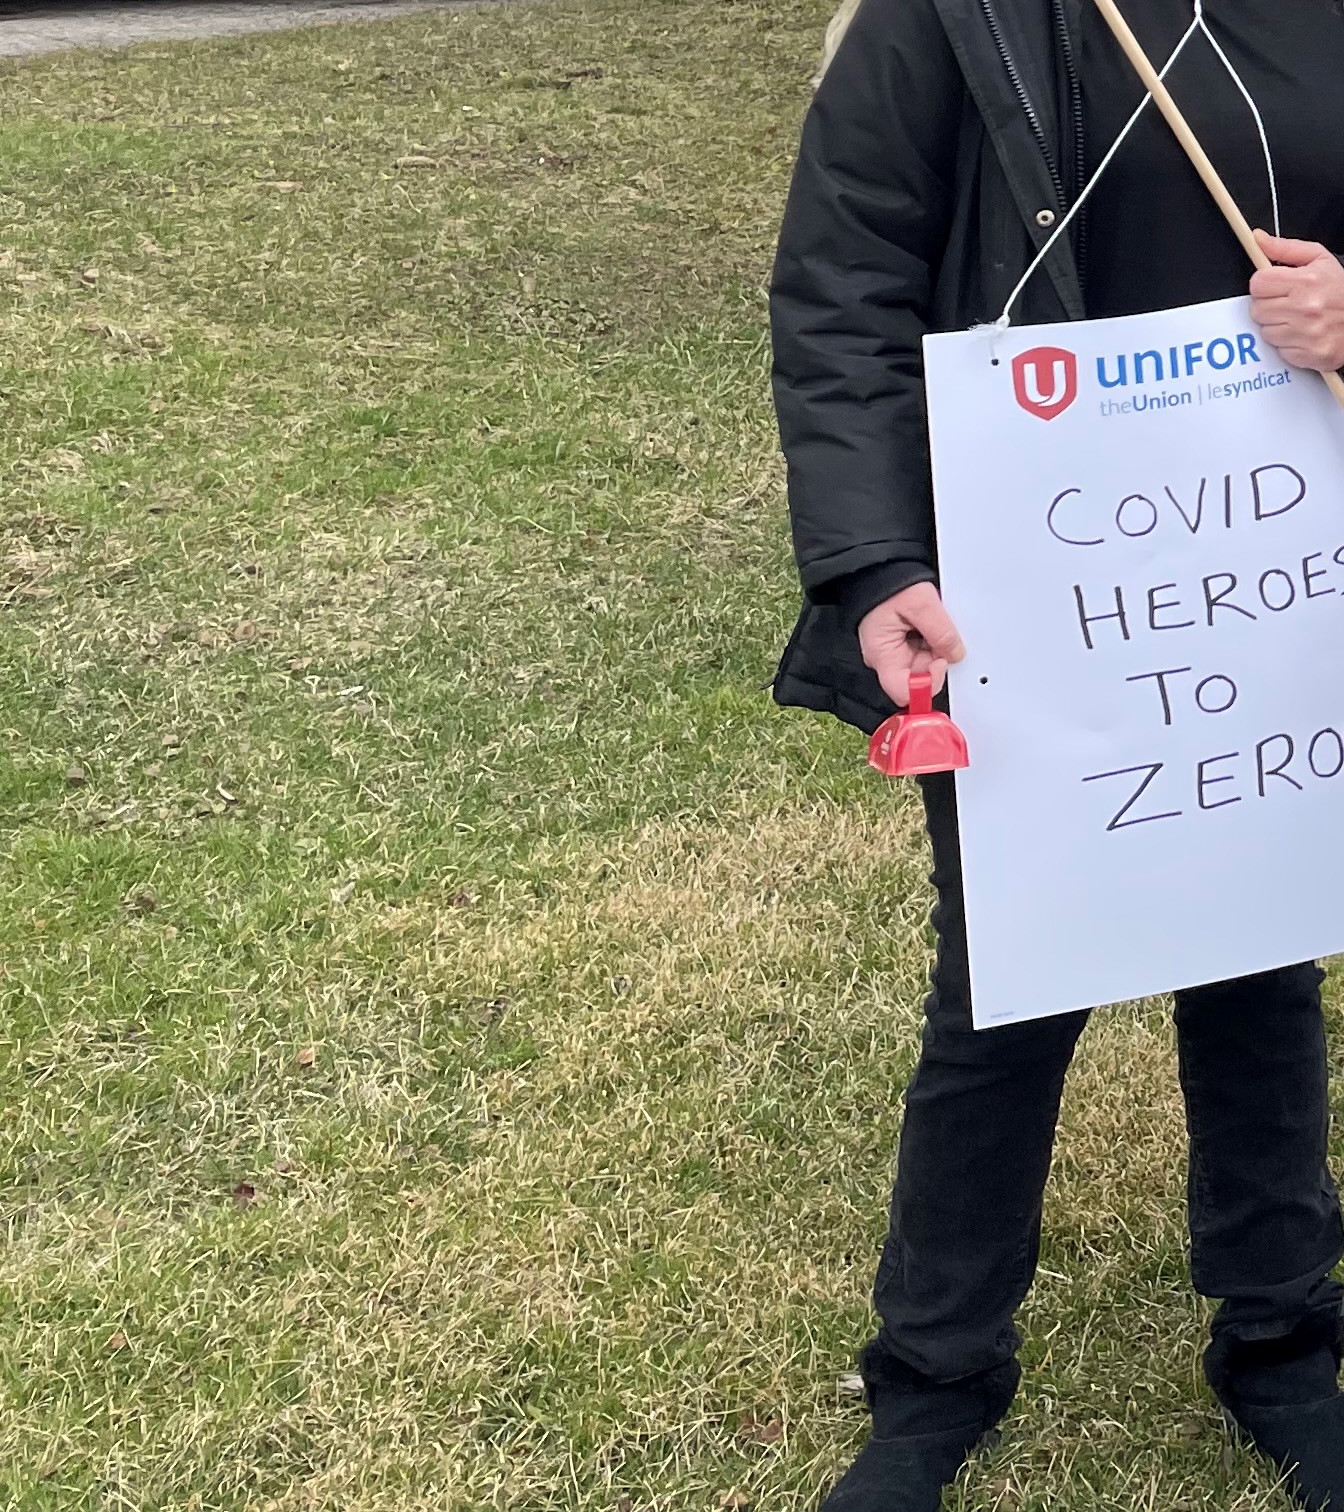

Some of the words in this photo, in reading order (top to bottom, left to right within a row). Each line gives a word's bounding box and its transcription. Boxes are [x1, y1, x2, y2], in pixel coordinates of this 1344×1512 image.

[1100, 391, 1191, 417] theUnion
[1207, 368, 1292, 401] lesyndicat
[1046, 463, 1307, 546] COVID
[1126, 666, 1237, 726] TO
